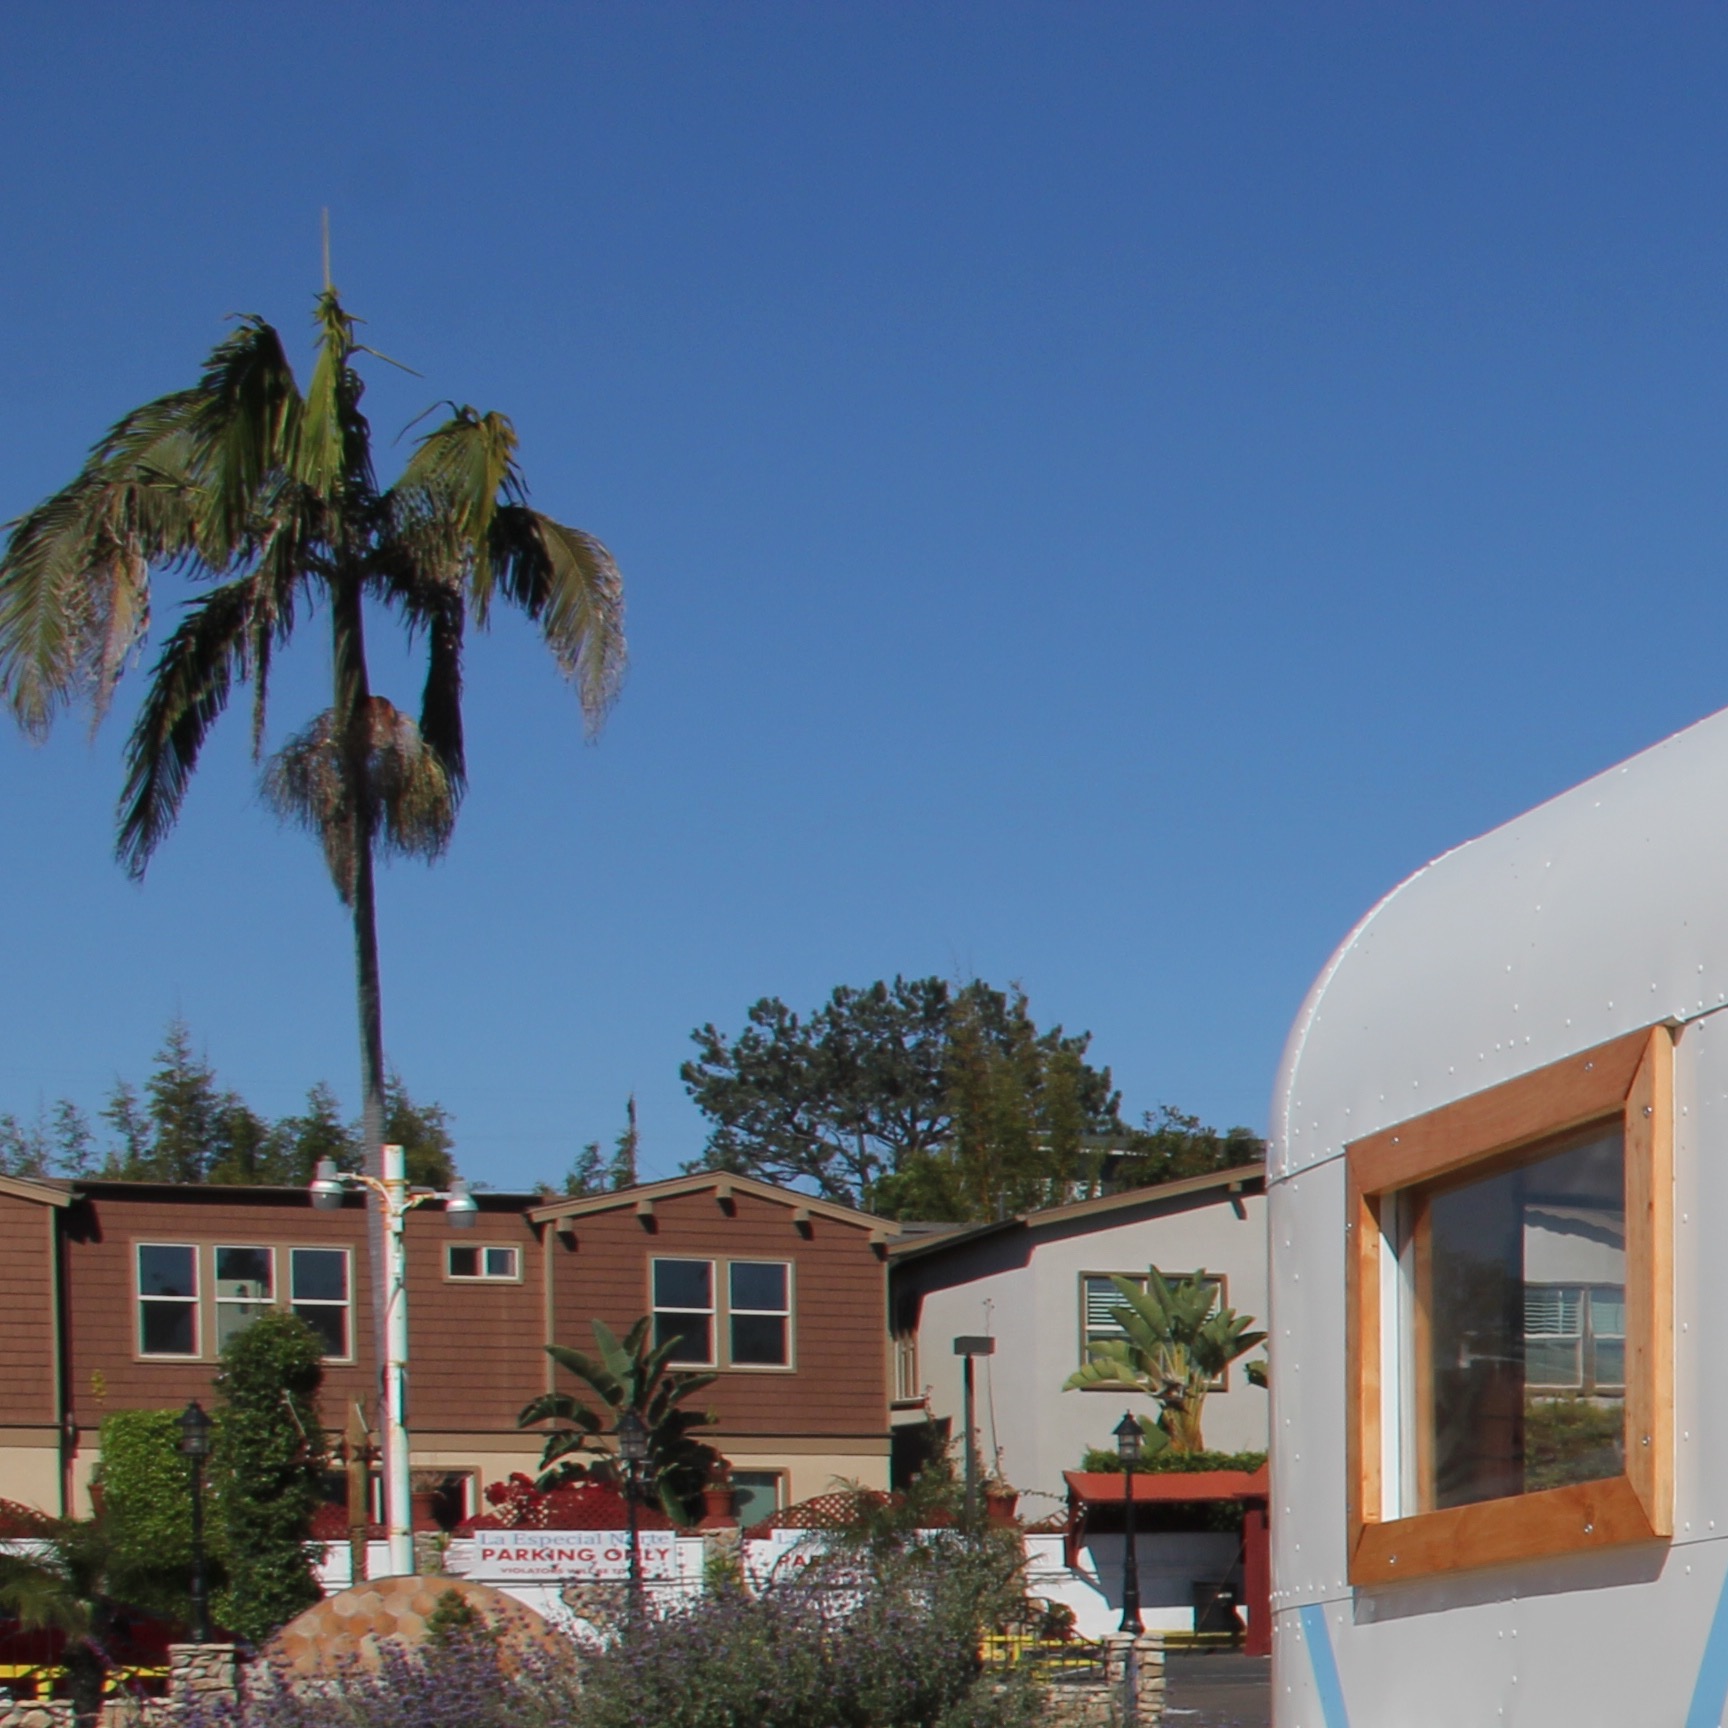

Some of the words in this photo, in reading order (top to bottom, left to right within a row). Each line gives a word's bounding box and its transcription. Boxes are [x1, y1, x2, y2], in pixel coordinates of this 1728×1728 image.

[480, 1533, 505, 1546] La
[514, 1532, 602, 1549] Especial
[611, 1533, 669, 1546] Nrte
[482, 1548, 596, 1562] PARKING
